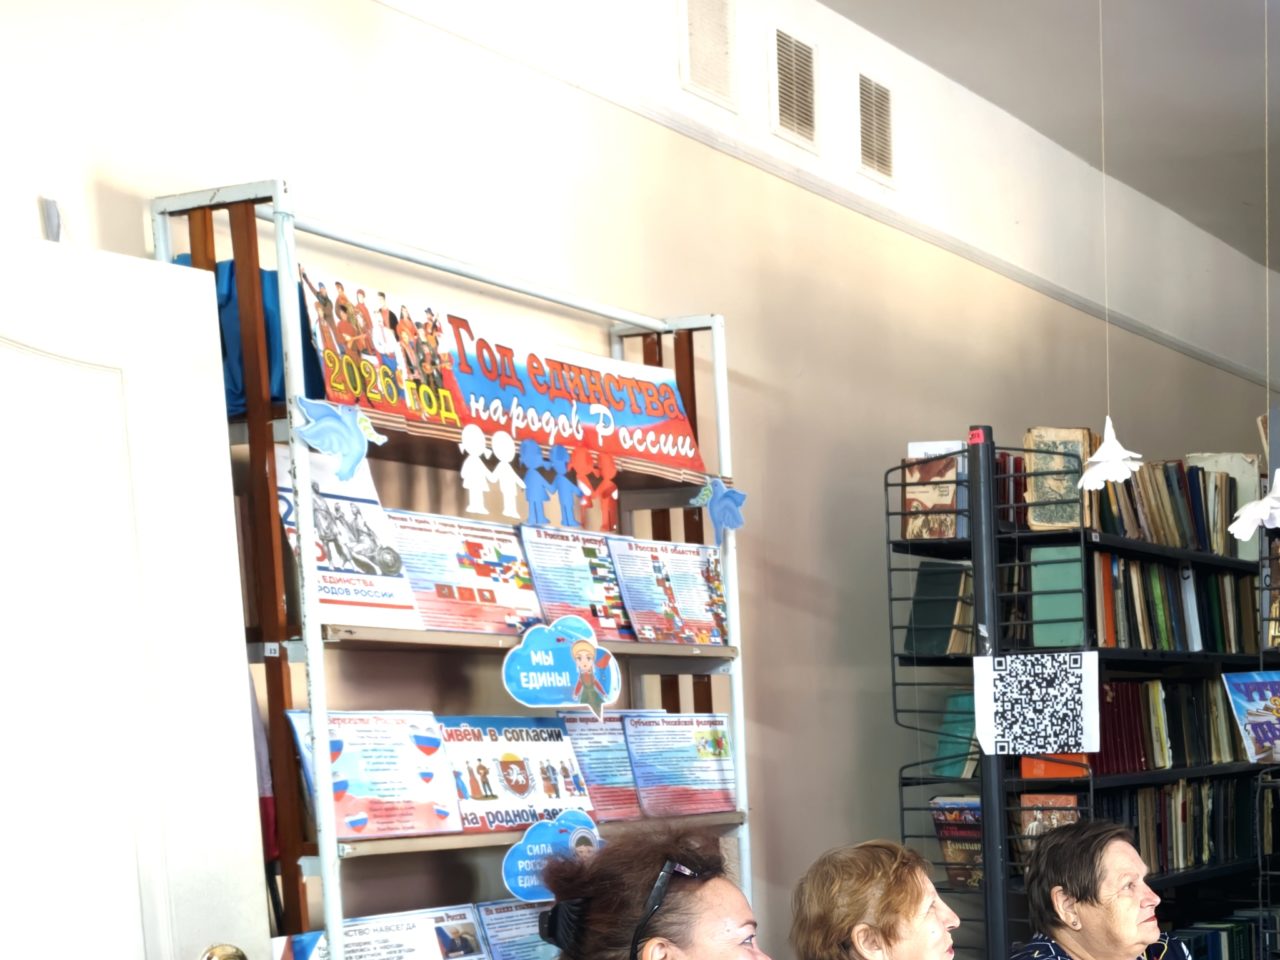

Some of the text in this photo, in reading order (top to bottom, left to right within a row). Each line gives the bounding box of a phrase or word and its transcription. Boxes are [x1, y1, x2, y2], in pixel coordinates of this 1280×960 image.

[447, 314, 685, 420] Год единства
[323, 349, 461, 427] 2026 год
[470, 393, 695, 458] народов России
[530, 650, 554, 666] МЫ
[520, 671, 571, 690] ЕДИНЫ!
[504, 729, 563, 742] согласии
[486, 804, 538, 827] родной
[527, 843, 552, 856] СИЛА
